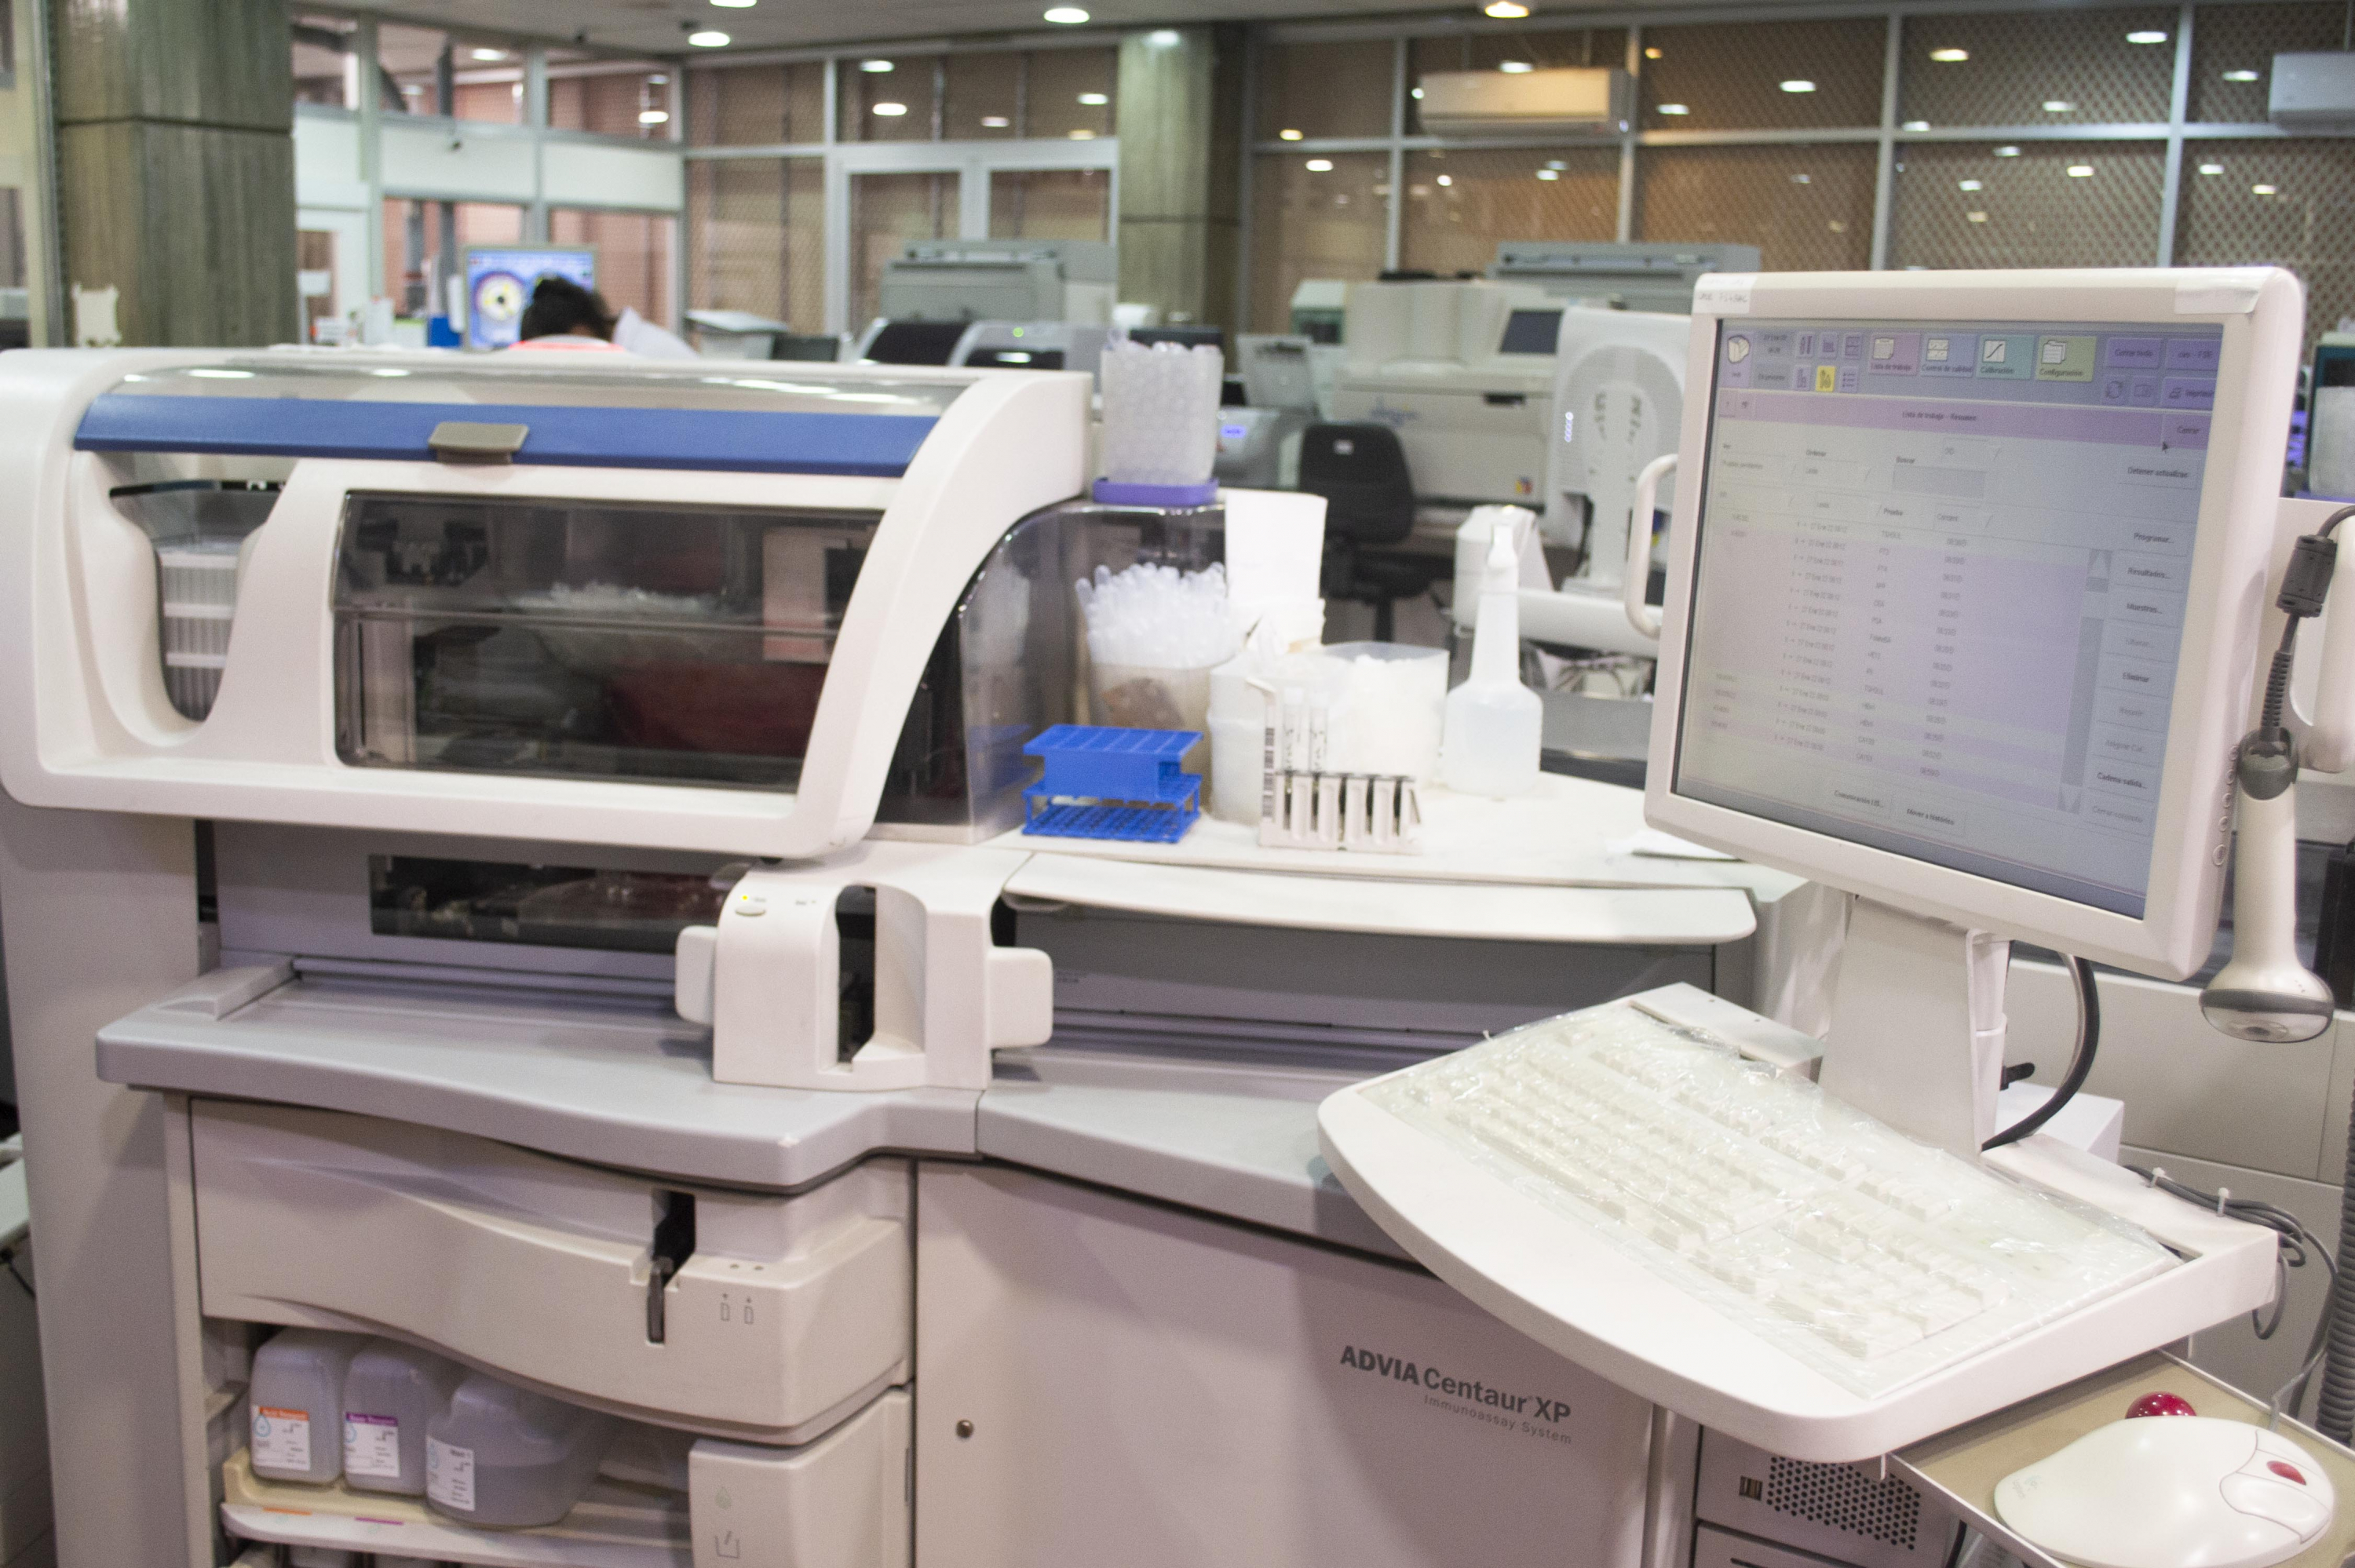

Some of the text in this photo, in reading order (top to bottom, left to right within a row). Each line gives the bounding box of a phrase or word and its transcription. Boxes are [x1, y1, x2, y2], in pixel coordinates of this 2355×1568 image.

[1339, 1345, 1419, 1386] ADVIA
[1533, 1395, 1571, 1424] XP
[1424, 1395, 1572, 1445] Immunoassay System
